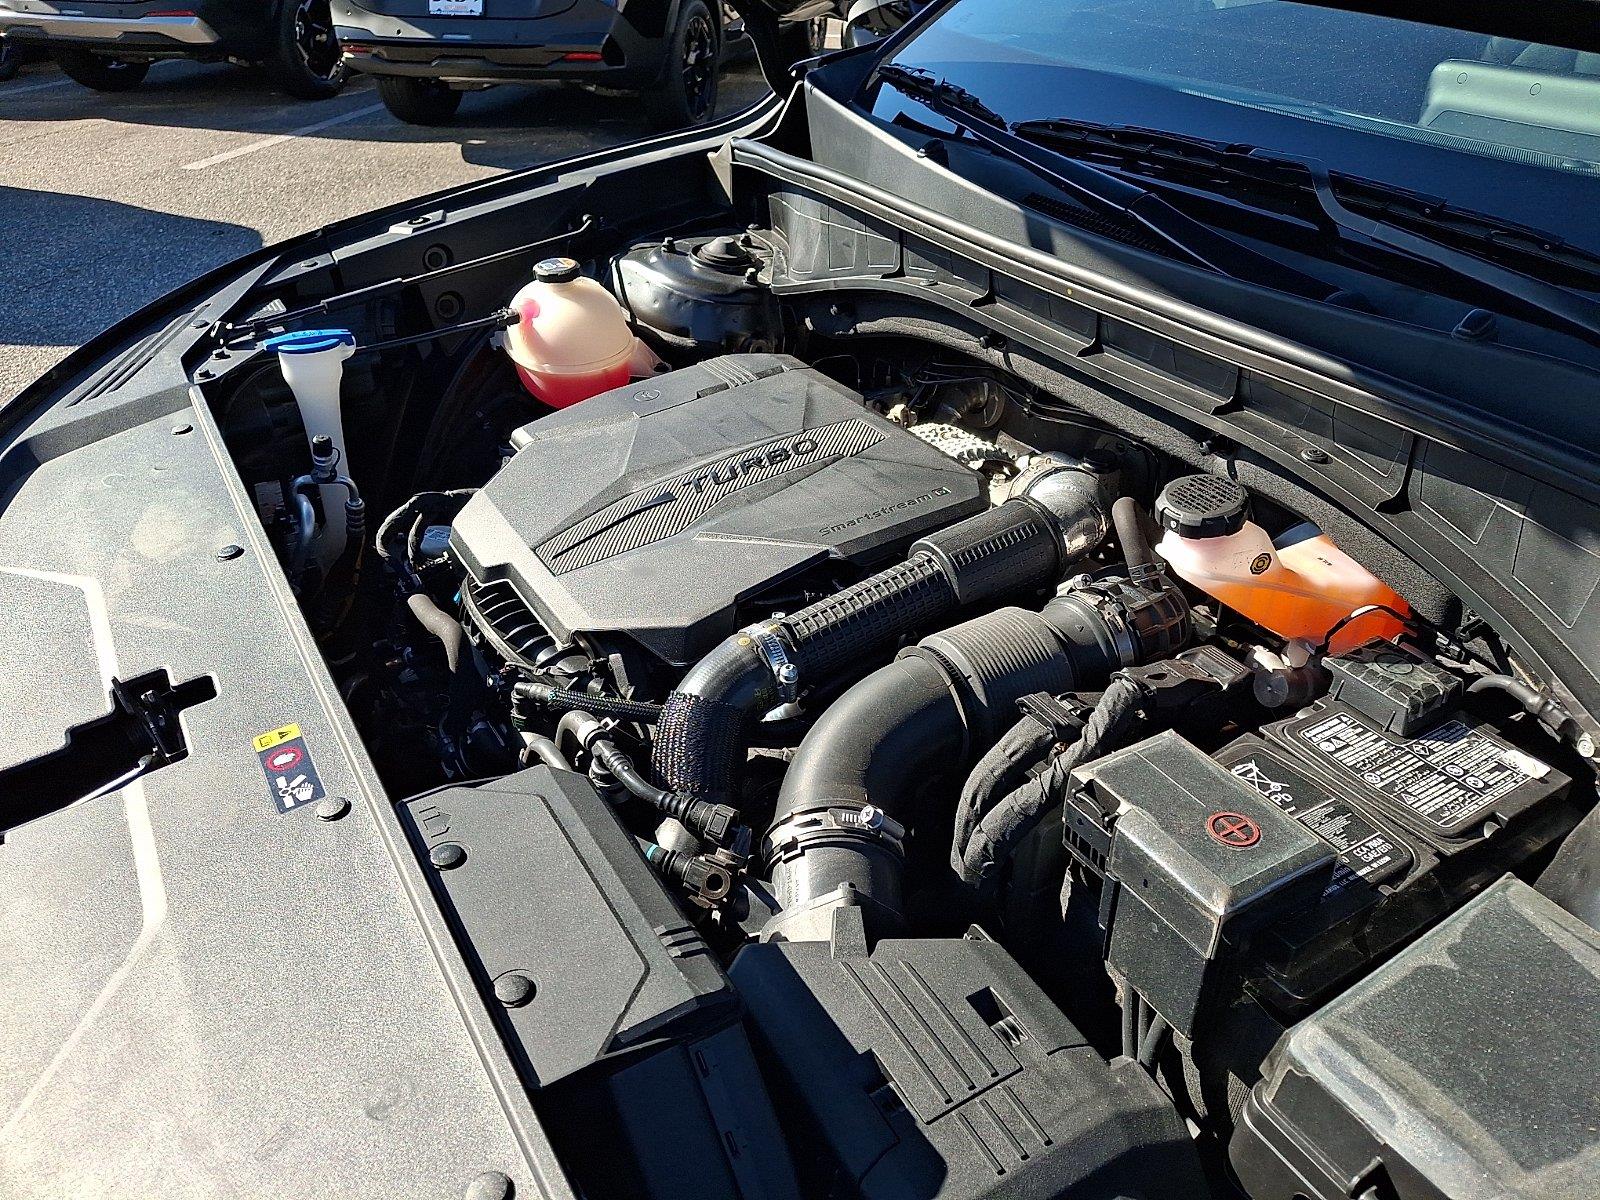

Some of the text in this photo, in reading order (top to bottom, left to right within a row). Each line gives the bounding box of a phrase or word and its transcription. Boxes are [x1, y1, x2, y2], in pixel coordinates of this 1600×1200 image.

[681, 439, 818, 494] TURBO
[819, 494, 932, 537] Smartstream
[1270, 793, 1293, 806] Pb
[1353, 844, 1371, 857] CCA
